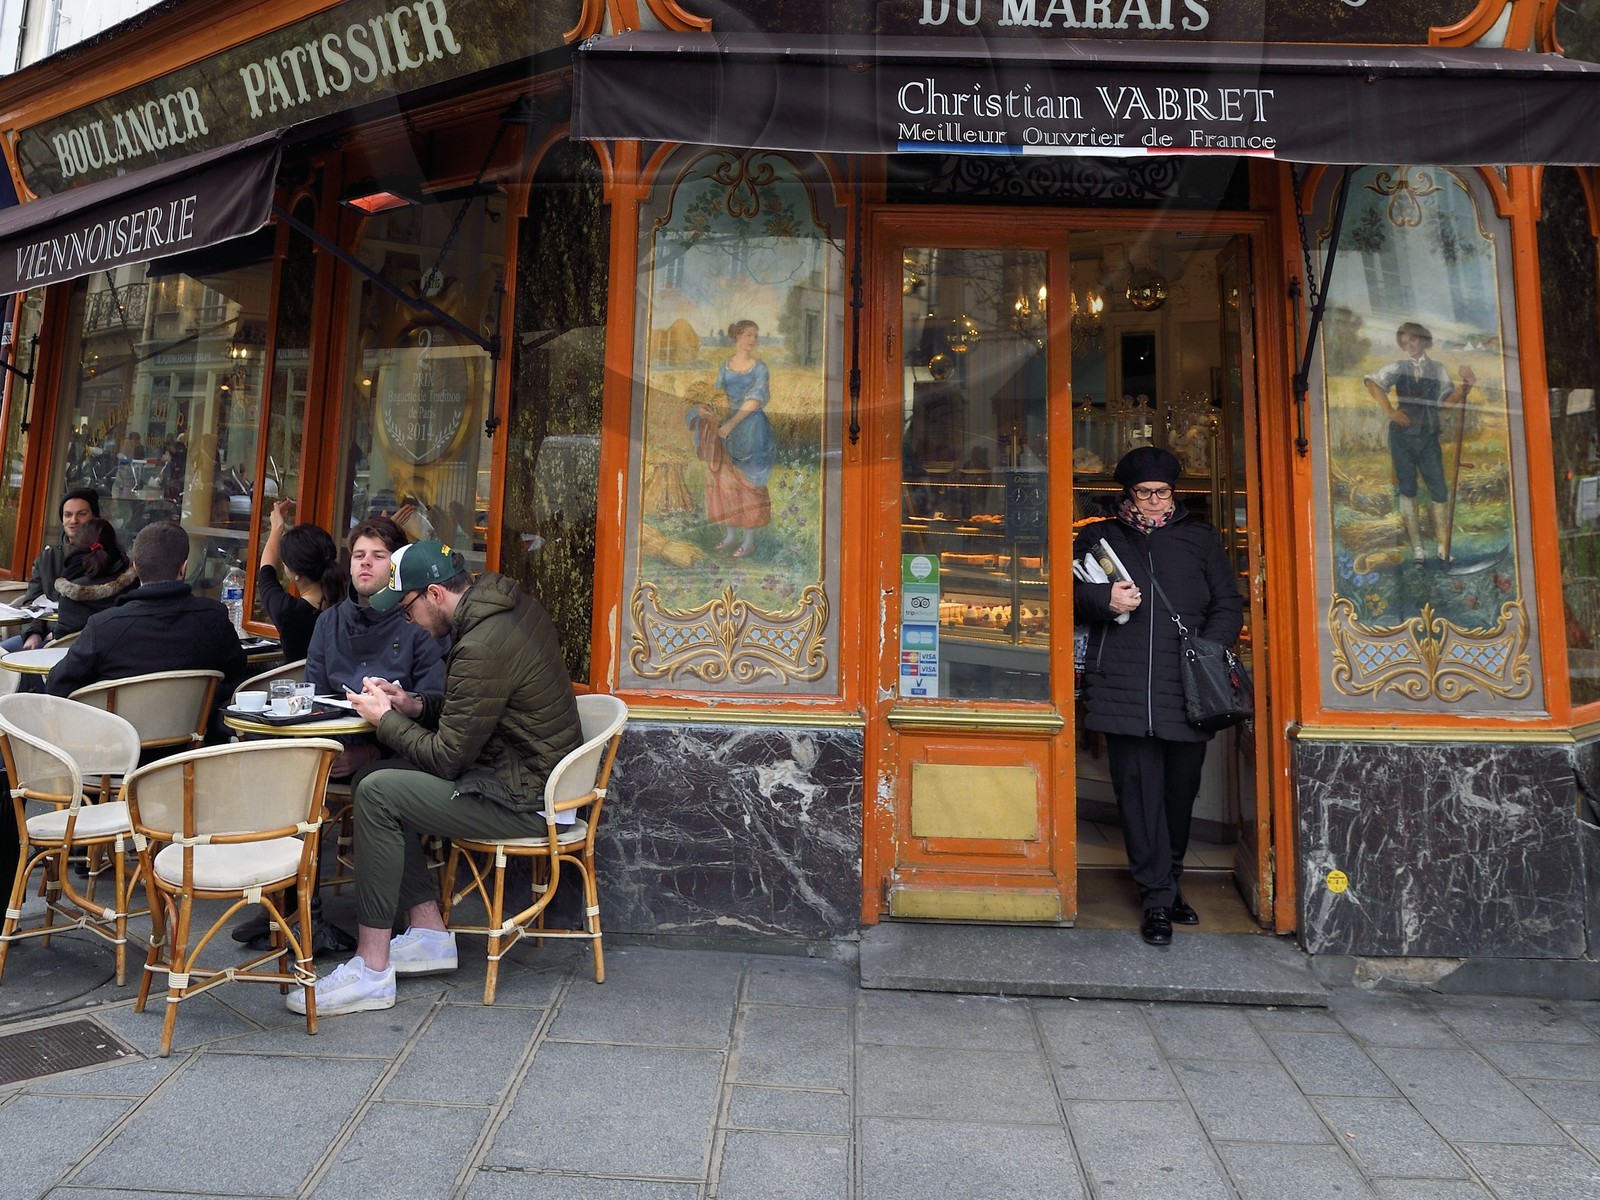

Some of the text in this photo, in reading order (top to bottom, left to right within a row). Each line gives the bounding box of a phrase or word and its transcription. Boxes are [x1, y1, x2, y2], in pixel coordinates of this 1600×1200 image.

[897, 77, 1275, 123] Christian VABRET
[52, 85, 209, 179] BOULANGER
[897, 121, 1278, 150] Meilleur Ouvrier de France
[15, 194, 198, 283] VIENNOISERIE
[412, 373, 436, 386] PRIX
[387, 390, 461, 405] Baguette de Tradition
[408, 406, 436, 419] de Paris
[407, 422, 434, 441] 2014
[915, 678, 923, 687] V
